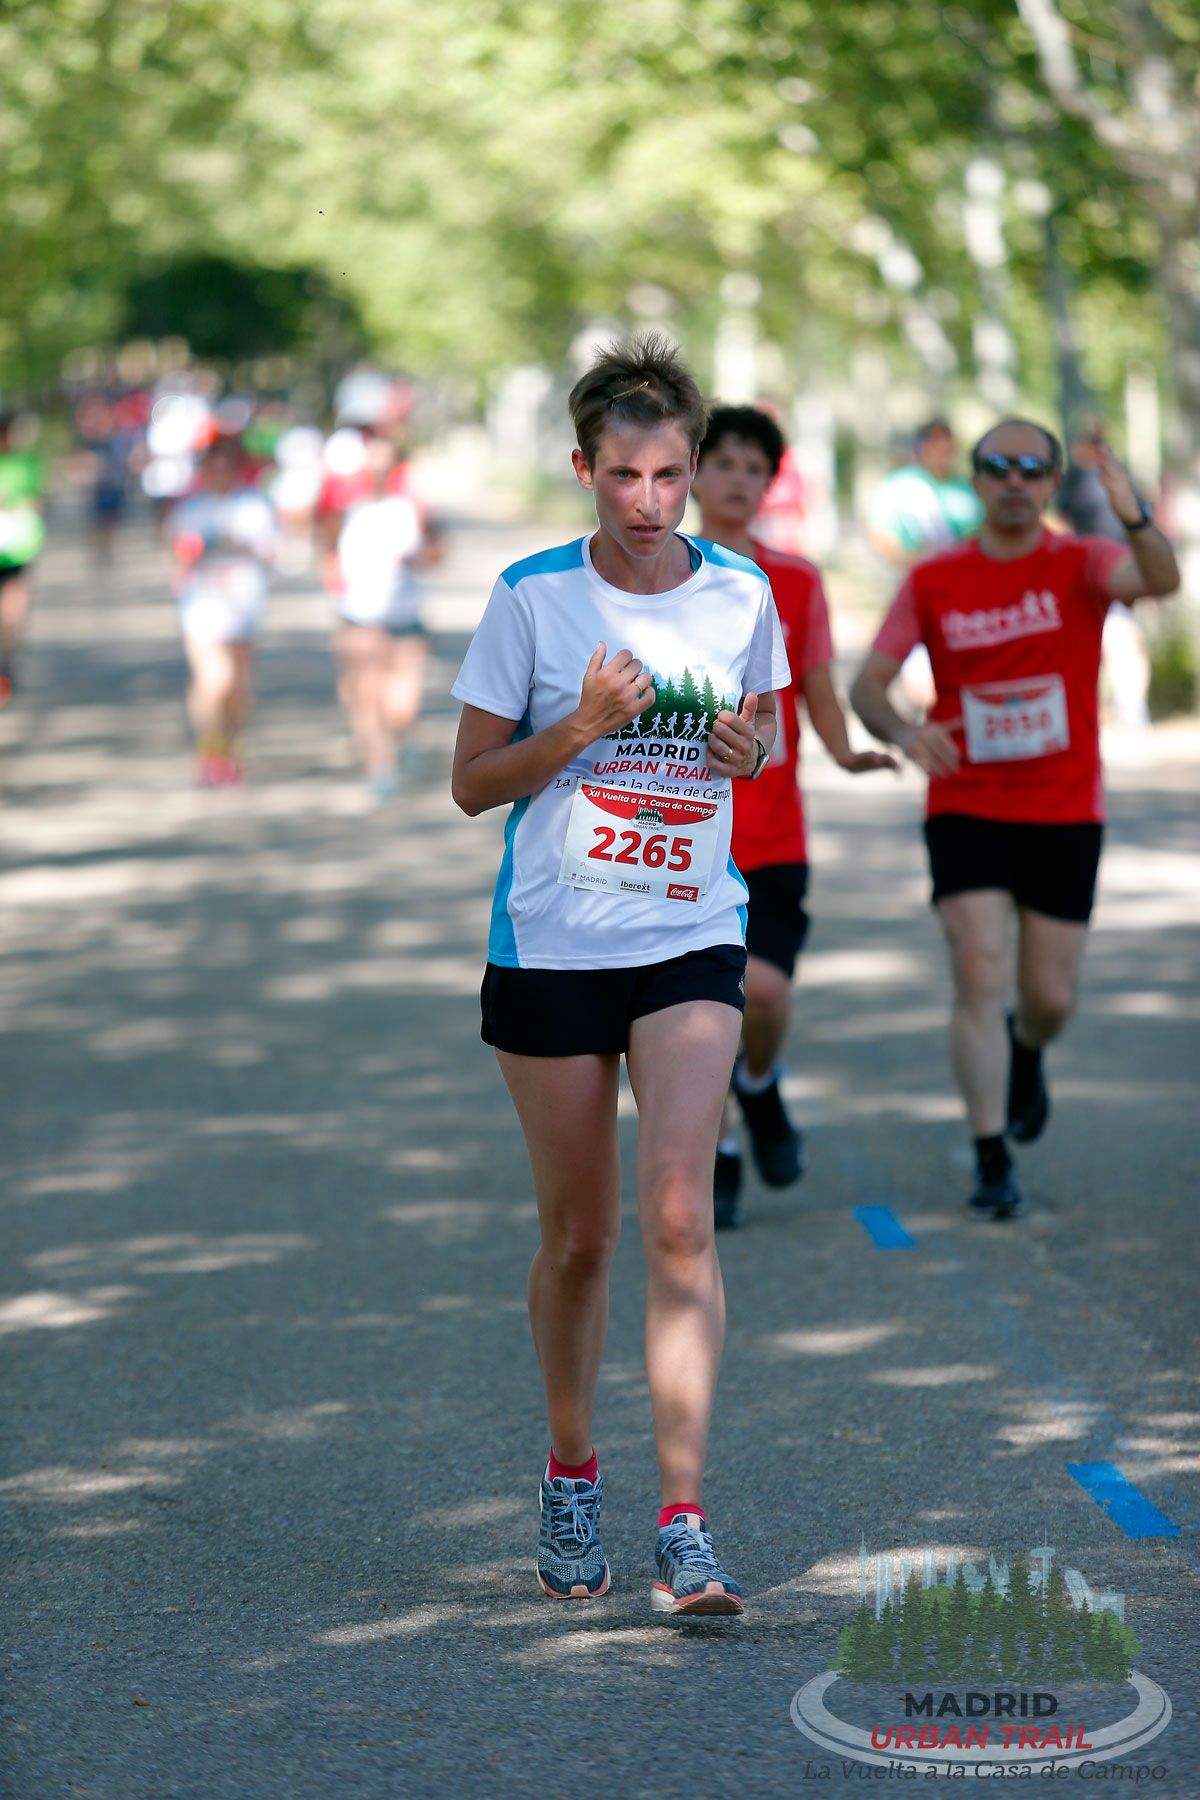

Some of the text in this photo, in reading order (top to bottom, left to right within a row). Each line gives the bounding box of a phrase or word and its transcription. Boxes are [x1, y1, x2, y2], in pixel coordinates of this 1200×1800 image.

[615, 743, 700, 761] MADRID
[593, 760, 711, 782] URBAN TRAIL
[554, 779, 571, 789] La
[630, 779, 643, 789] la
[647, 780, 680, 795] Casa
[683, 786, 700, 798] de
[602, 791, 630, 803] Vuelta
[638, 797, 647, 805] la
[650, 799, 670, 808] Casa
[672, 802, 682, 810] de
[684, 804, 716, 817] Campo
[587, 826, 693, 872] 2265
[580, 875, 608, 885] MADRID
